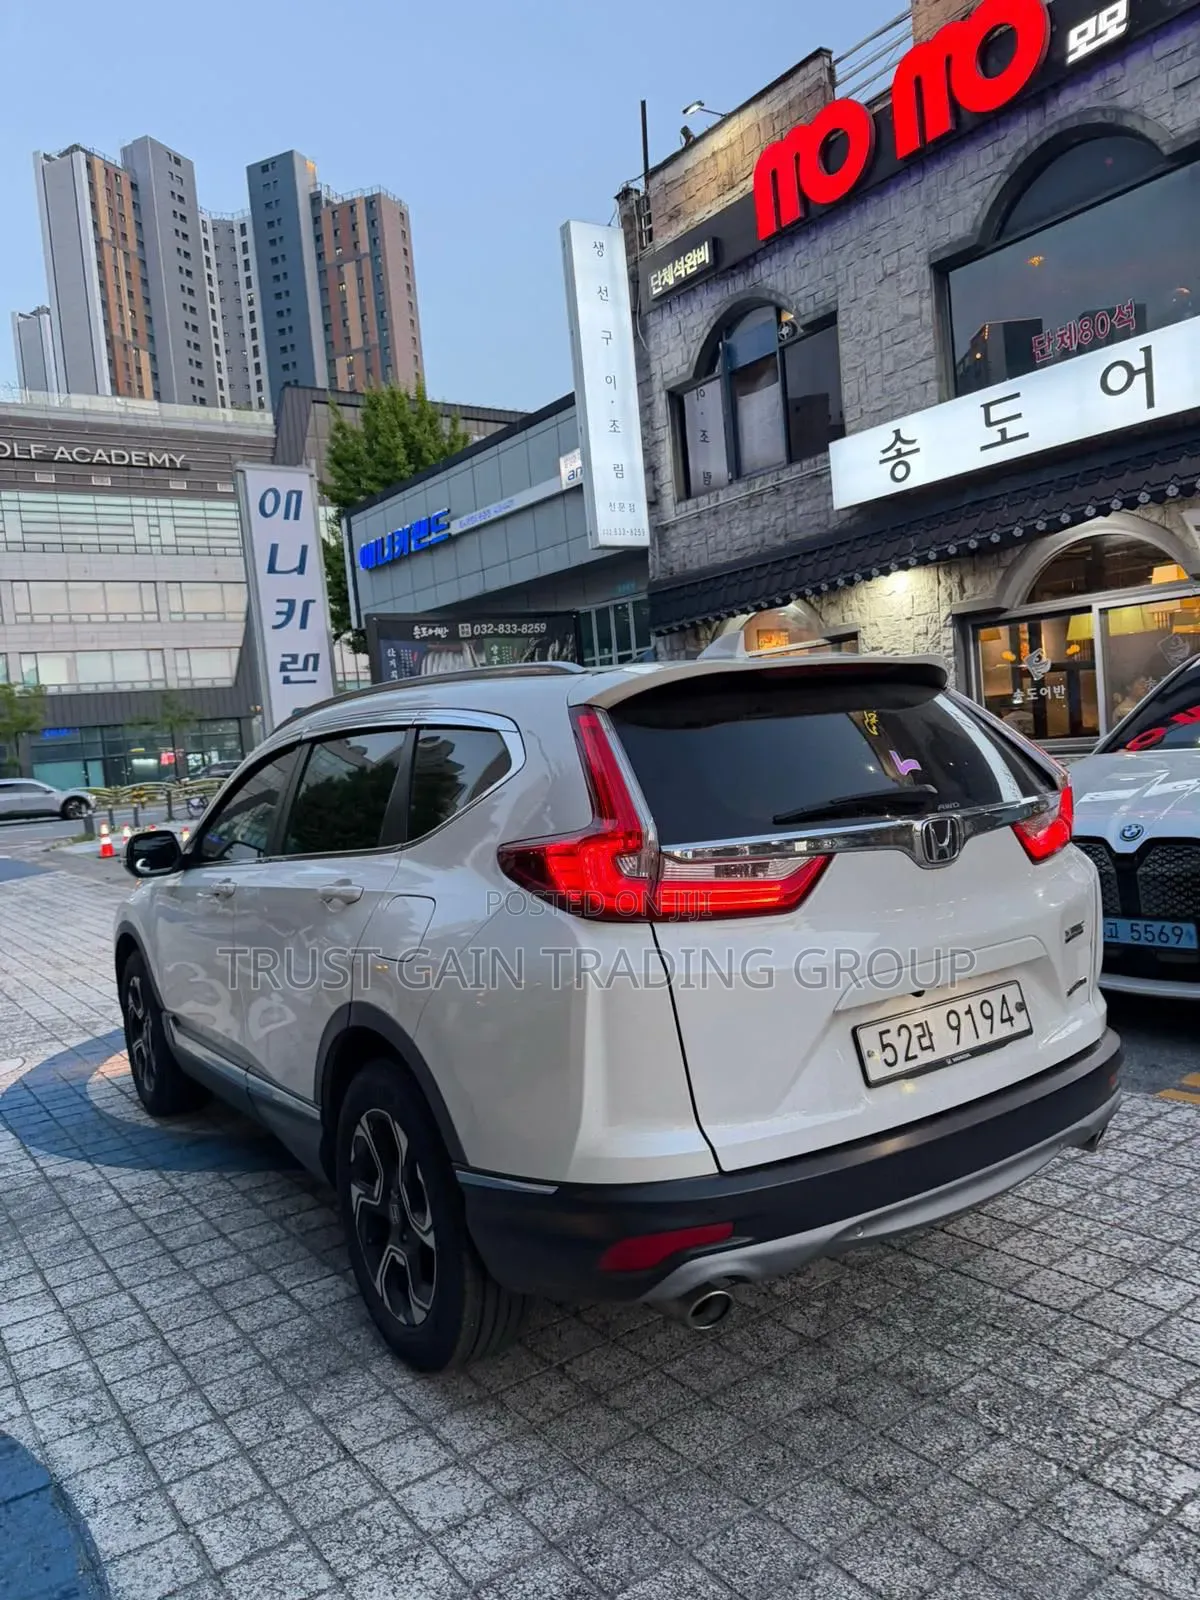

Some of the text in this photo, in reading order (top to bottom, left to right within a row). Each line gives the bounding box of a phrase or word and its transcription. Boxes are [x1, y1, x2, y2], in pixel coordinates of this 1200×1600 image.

[650, 241, 709, 296] 단체석완비
[1032, 298, 1136, 364] 단체80석
[54, 446, 186, 469] ACADEMY
[359, 507, 451, 570] 애니카랜드
[473, 623, 547, 635] 032-833-8259
[1012, 684, 1066, 704] 송도어반
[1130, 922, 1184, 944] 5569
[878, 993, 1014, 1068] 52라 9194
